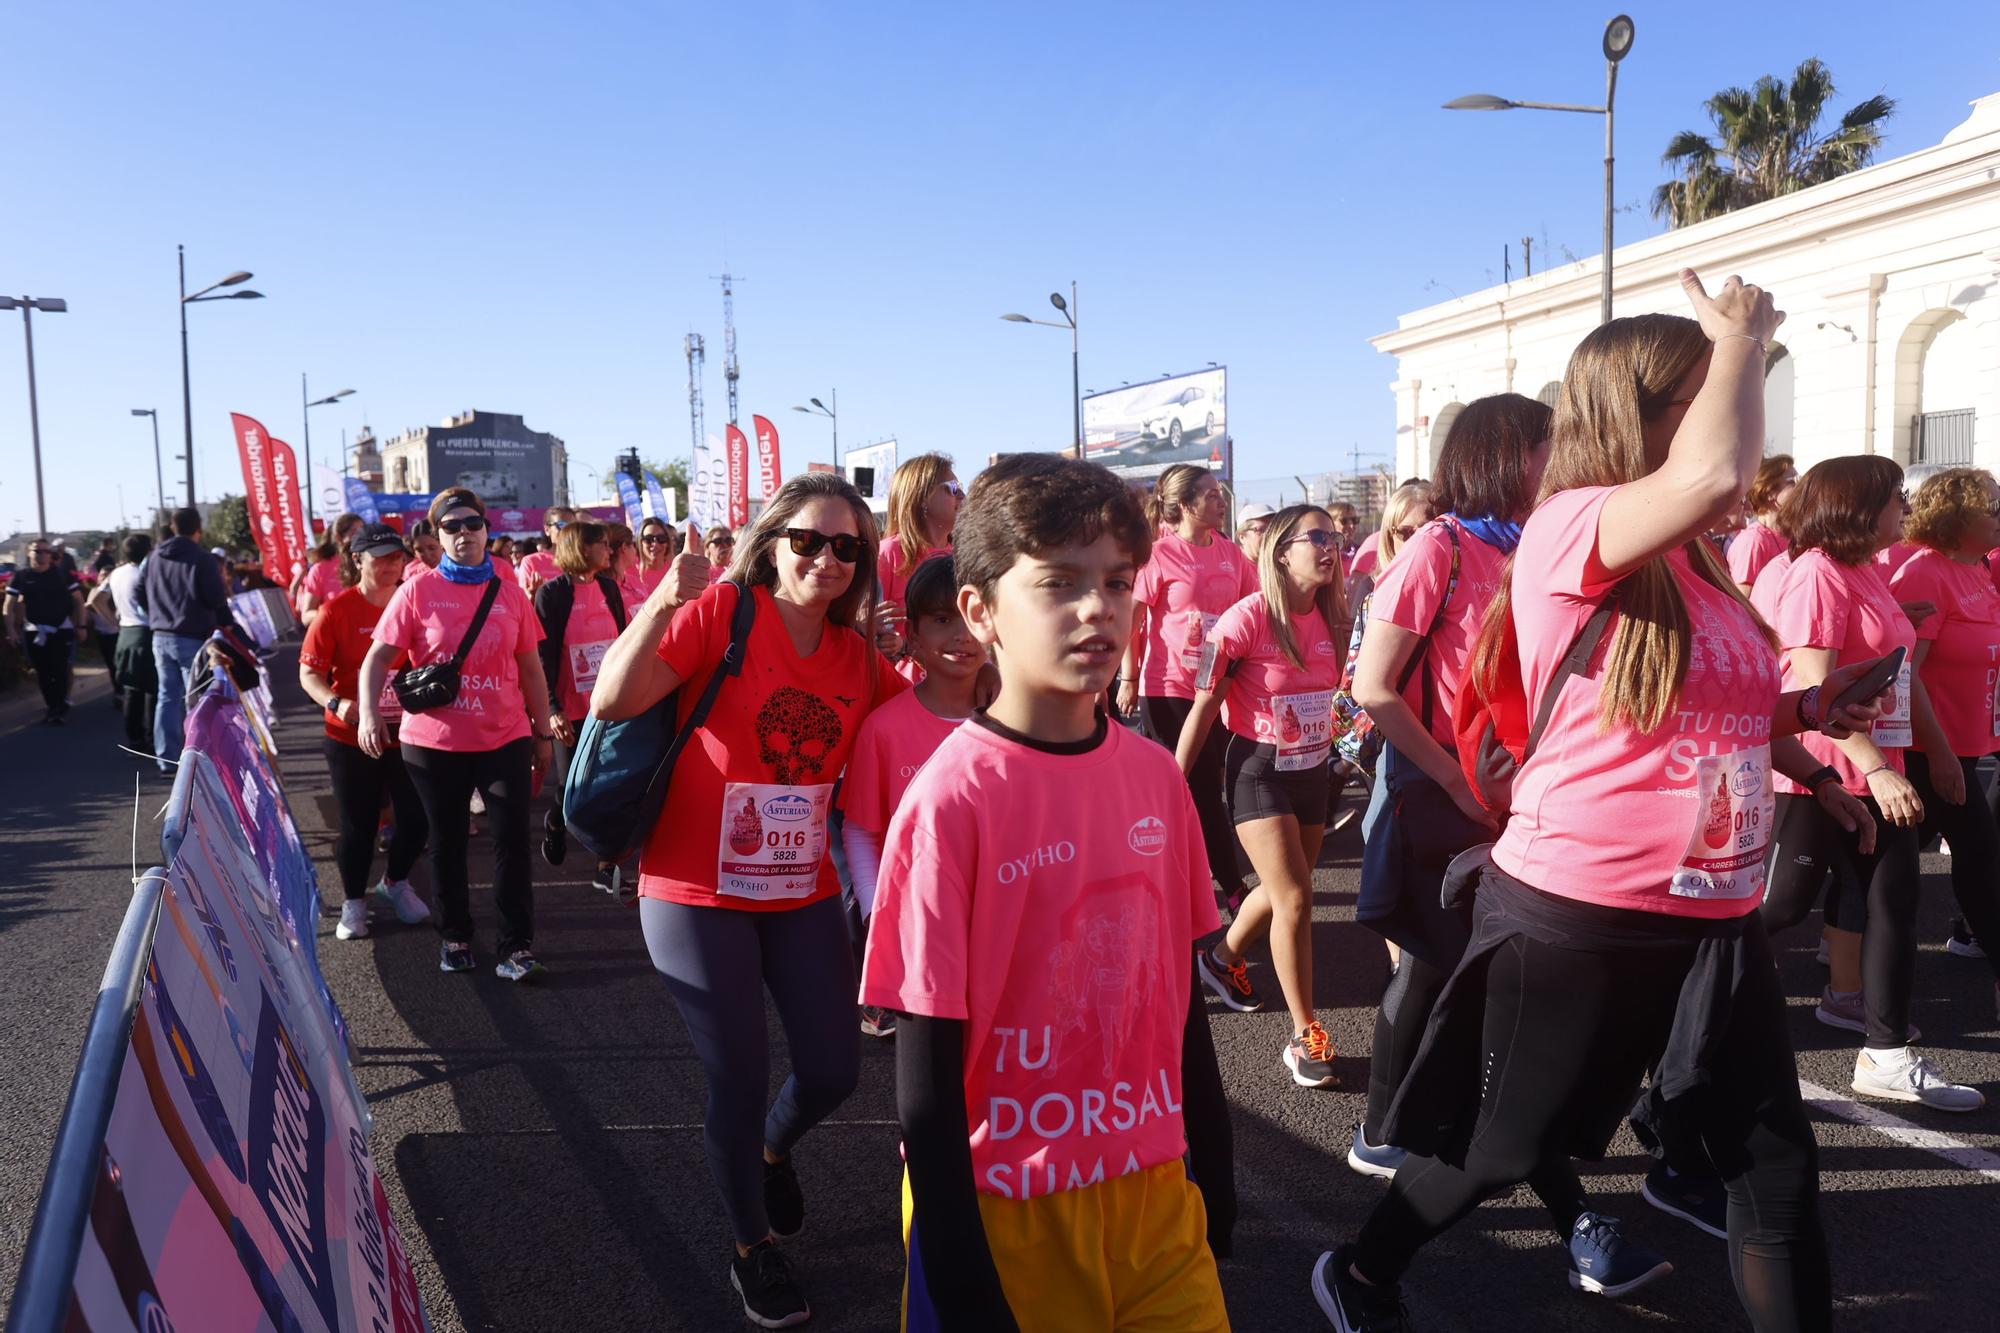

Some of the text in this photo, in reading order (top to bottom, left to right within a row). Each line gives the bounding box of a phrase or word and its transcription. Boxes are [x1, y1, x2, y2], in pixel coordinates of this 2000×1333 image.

[447, 438, 480, 448] PUERTO
[461, 675, 502, 690] RSAL
[1302, 721, 1325, 734] 016
[1678, 711, 1714, 733] TU
[1657, 786, 1700, 799] CARRER
[767, 804, 810, 815] ASTURIANA
[1734, 806, 1759, 831] 016
[766, 831, 806, 847] 016
[772, 851, 797, 860] 5828
[734, 866, 769, 874] CARRERA
[790, 865, 811, 873] MUJER
[1702, 859, 1738, 870] CARRERA
[730, 879, 769, 892] OYSHO
[994, 1024, 1052, 1073] TU
[988, 1067, 1182, 1141] DORSAL
